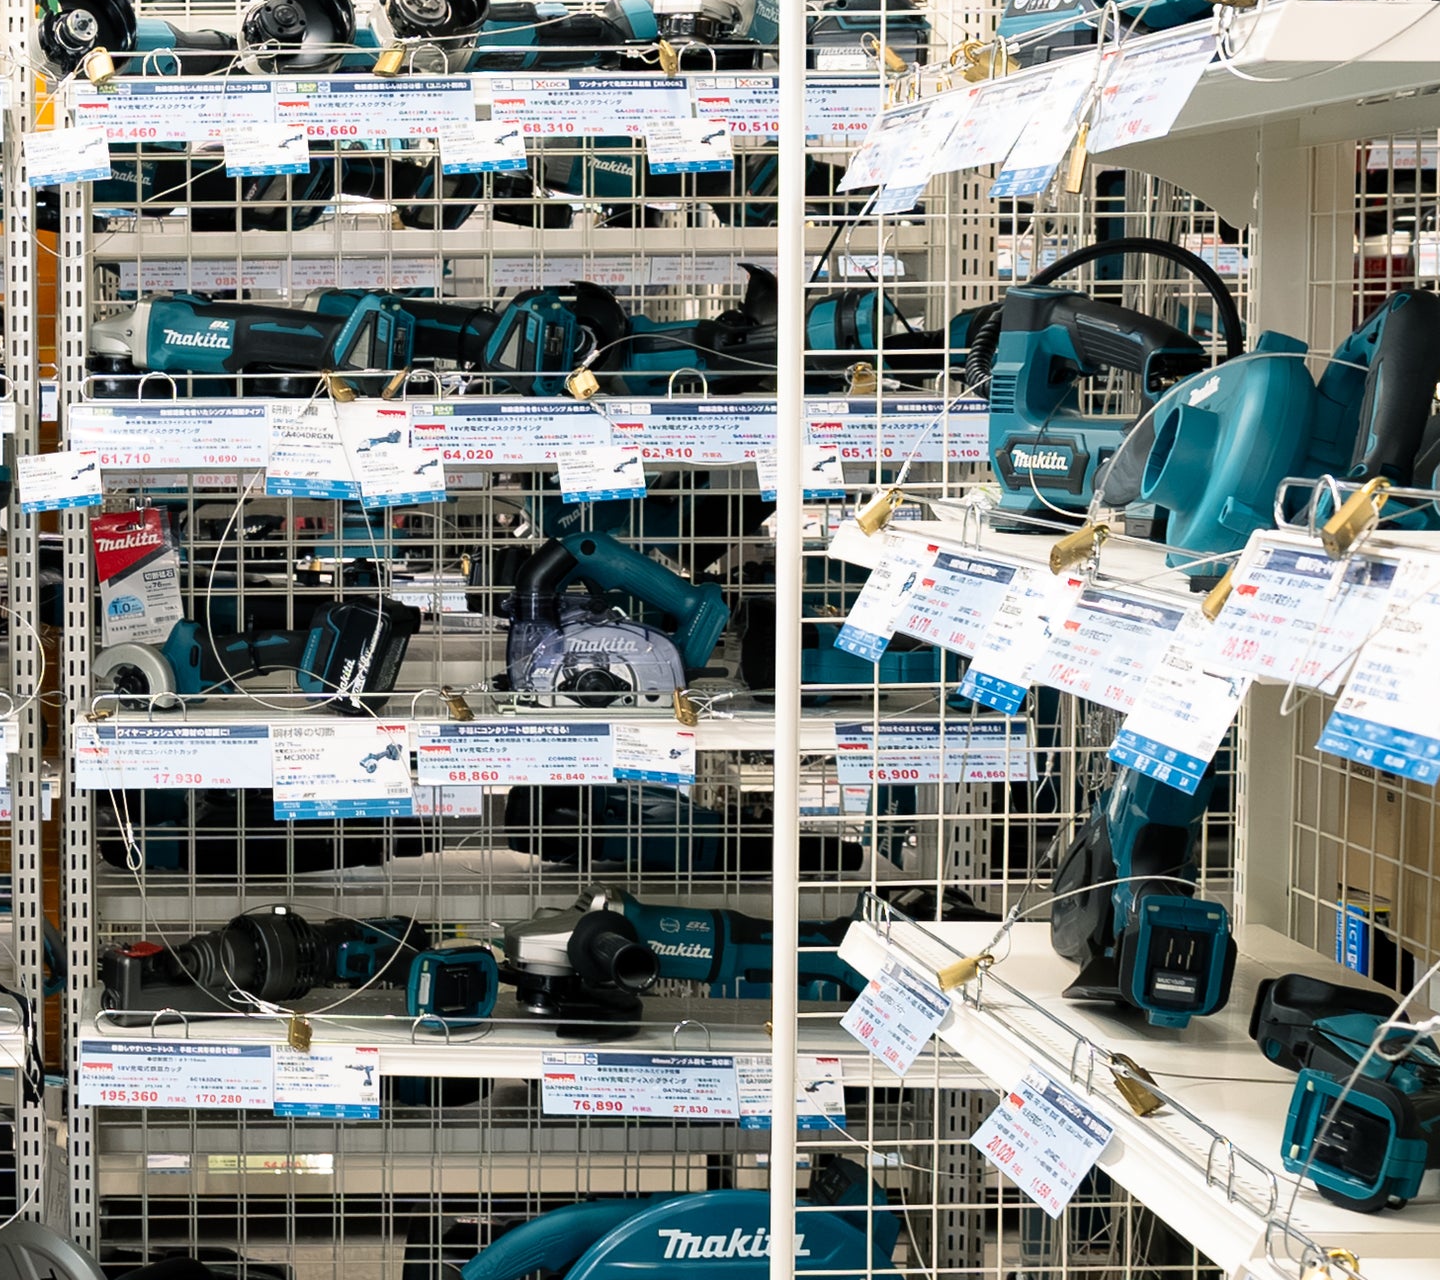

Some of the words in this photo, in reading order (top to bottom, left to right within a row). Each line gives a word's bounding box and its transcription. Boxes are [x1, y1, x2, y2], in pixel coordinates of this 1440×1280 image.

[409, 126, 440, 135] 24,64
[523, 123, 574, 133] 68,310
[730, 121, 780, 133] 70,510
[831, 122, 868, 131] 28,490
[162, 328, 233, 350] Makita
[100, 453, 151, 464] 61,710
[202, 455, 238, 463] 19,690
[442, 450, 494, 460] 64,020
[642, 448, 693, 459] 62,810
[1009, 446, 1070, 475] Makita
[93, 528, 161, 554] Makita
[565, 637, 640, 655] Makita
[152, 773, 202, 785] 17,930
[448, 770, 500, 783] 68,860
[549, 772, 586, 782] 26,840
[646, 937, 715, 961] Makita
[99, 1090, 159, 1103] 195,360
[195, 1093, 243, 1104] 170,280
[572, 1100, 623, 1112] 76,890
[673, 1105, 708, 1114] 27,830
[658, 1227, 811, 1260] Makia
